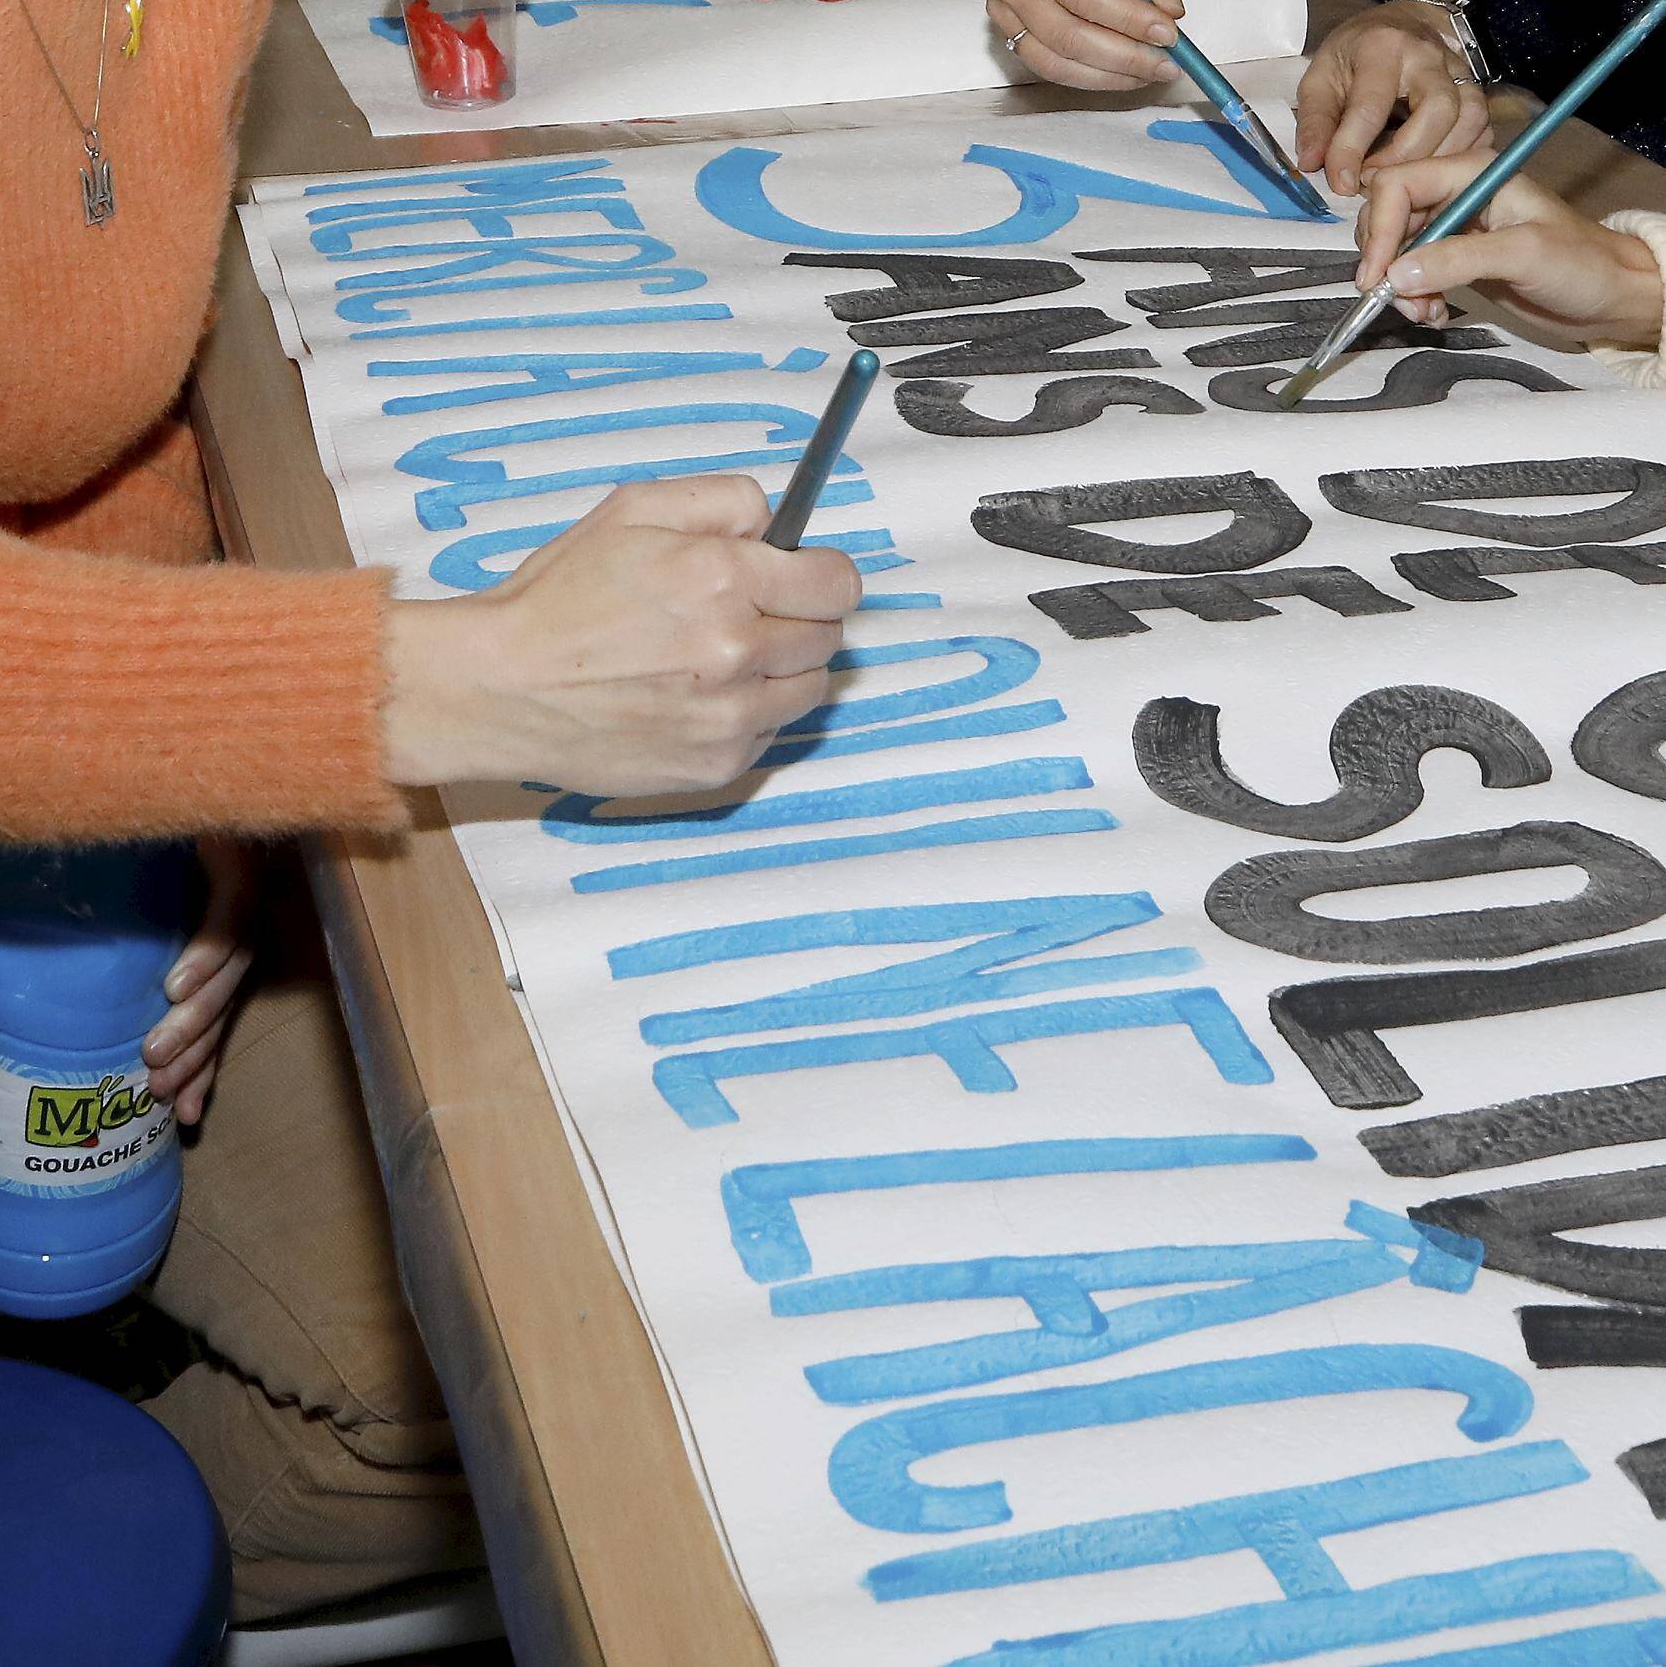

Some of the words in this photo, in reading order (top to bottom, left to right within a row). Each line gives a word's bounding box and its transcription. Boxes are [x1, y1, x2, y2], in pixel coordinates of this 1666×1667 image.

[303, 157, 735, 341] MERCI
[1071, 244, 1581, 414] ANS
[366, 346, 830, 417] À
[782, 251, 1206, 437] ANS
[969, 469, 1415, 641] DE
[606, 890, 1276, 1130] NE
[24, 1137, 142, 1173] GOUACHE
